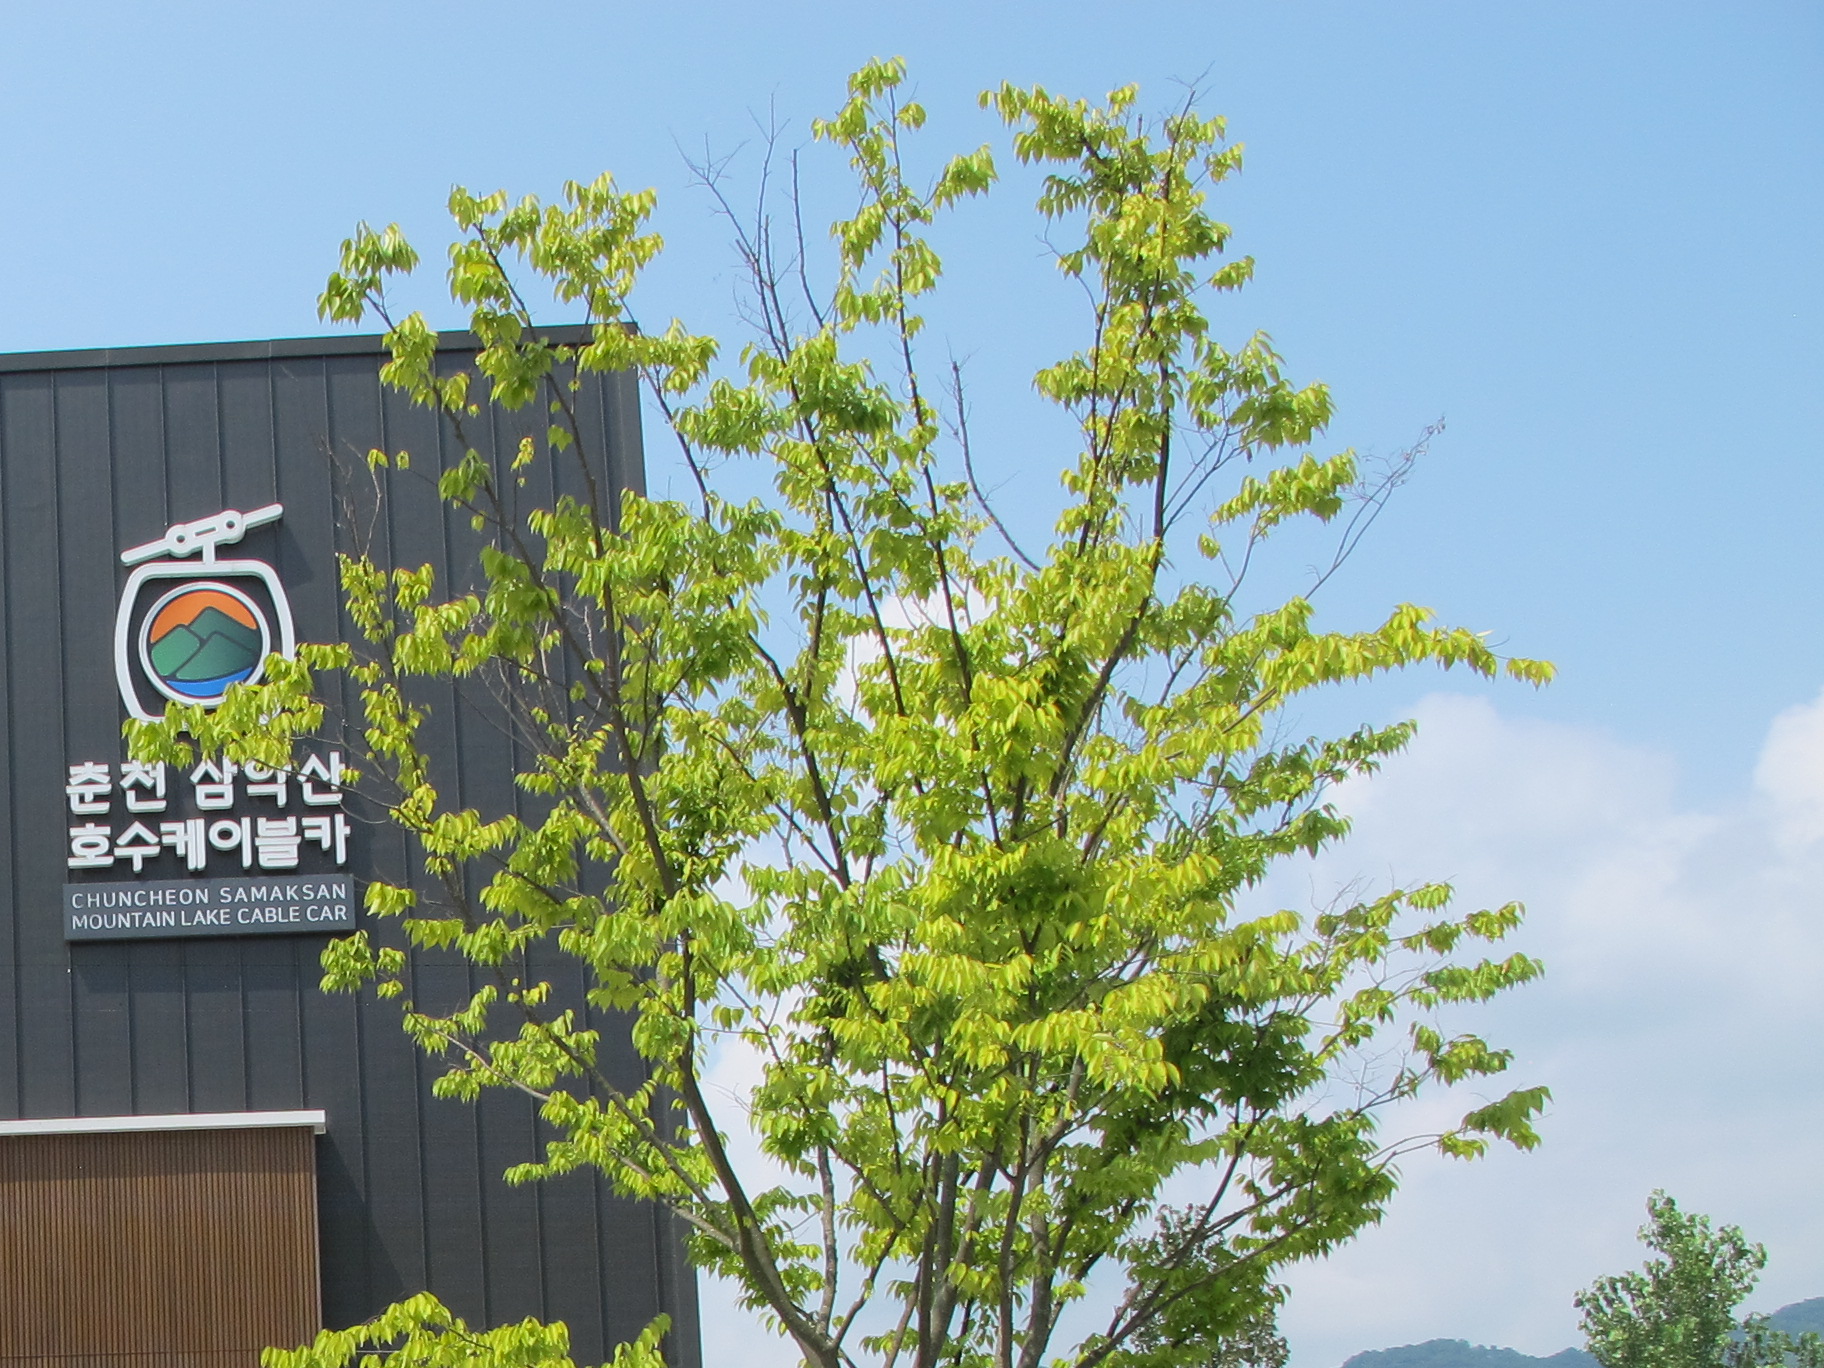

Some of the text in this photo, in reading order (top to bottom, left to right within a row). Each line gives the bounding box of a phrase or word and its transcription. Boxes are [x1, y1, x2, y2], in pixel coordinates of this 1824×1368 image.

[65, 751, 346, 815] 춘천 삼악산
[67, 813, 351, 874] 호수케이블카
[71, 883, 347, 910] CHUNCHEON SAMAKSAN
[71, 904, 347, 930] MOUNTAIN LAKE CABLE CAR
